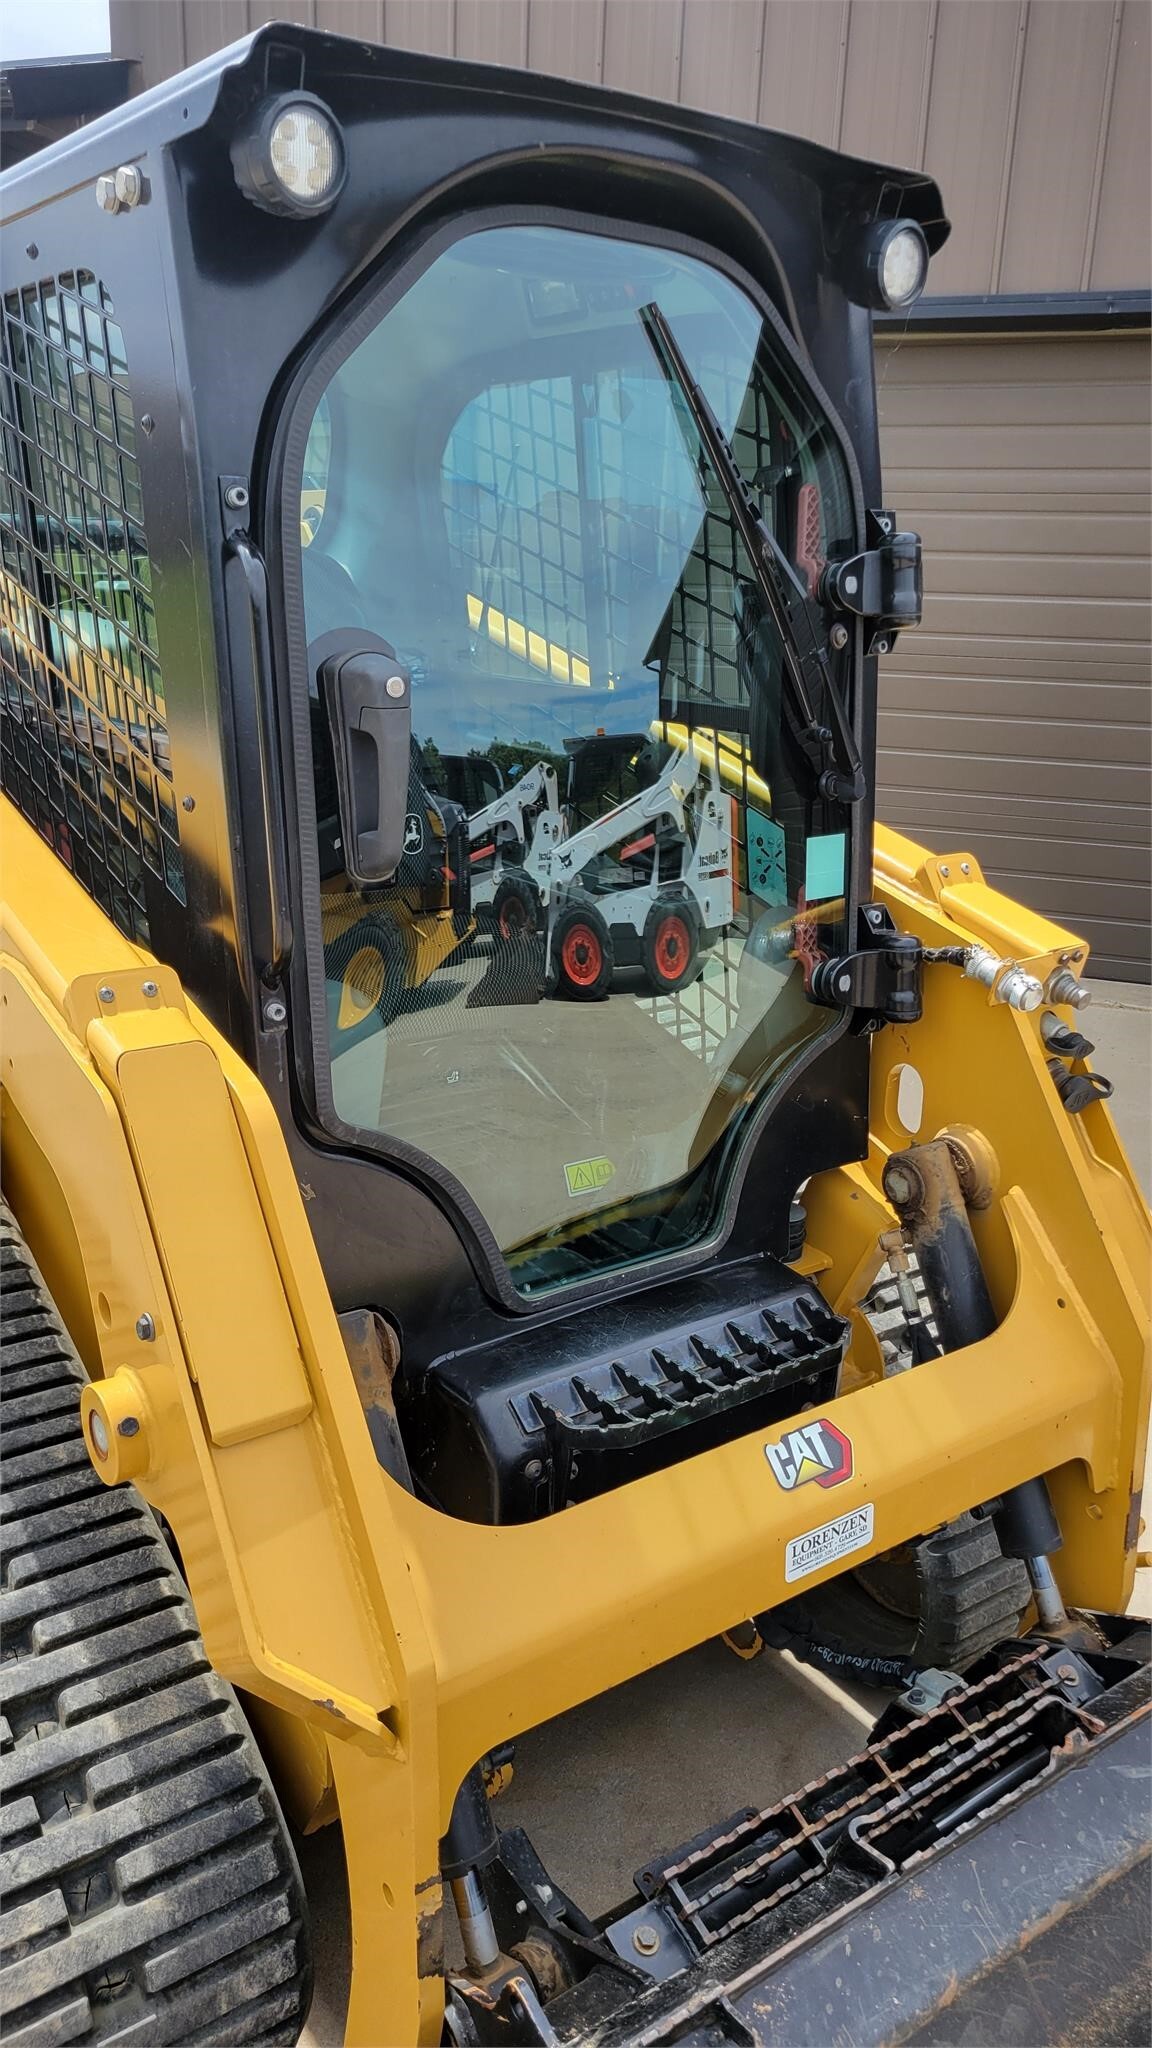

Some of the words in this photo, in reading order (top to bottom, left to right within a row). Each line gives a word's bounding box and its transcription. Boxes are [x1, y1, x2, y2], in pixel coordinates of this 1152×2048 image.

[766, 1423, 834, 1489] CAT
[792, 1511, 869, 1559] LORENZEN
[792, 1541, 833, 1567] EQUIPMENT
[859, 1524, 868, 1534] SD
